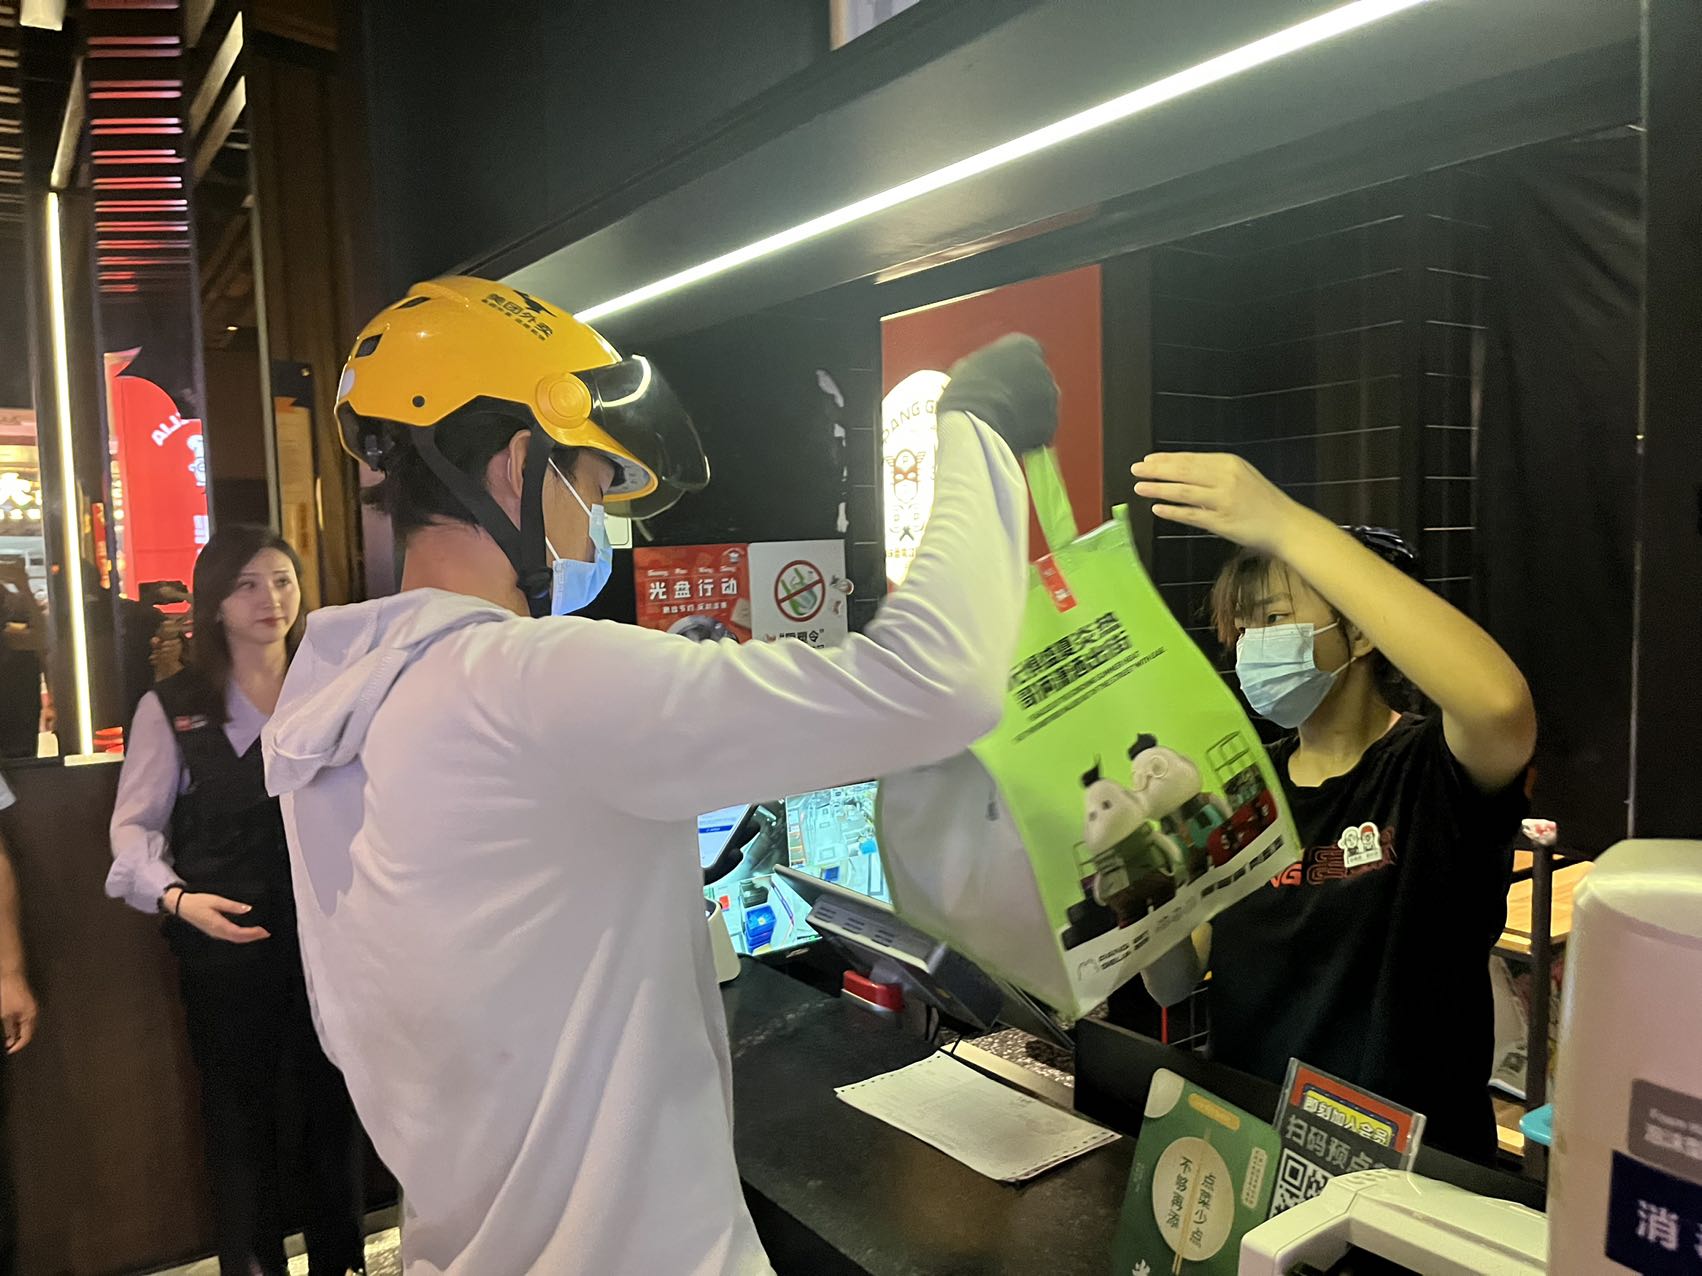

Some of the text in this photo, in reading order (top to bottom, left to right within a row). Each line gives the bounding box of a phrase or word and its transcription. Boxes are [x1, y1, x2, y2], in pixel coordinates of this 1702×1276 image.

[649, 577, 738, 600] 光盘行动
[1285, 1114, 1387, 1172] 扫码预点
